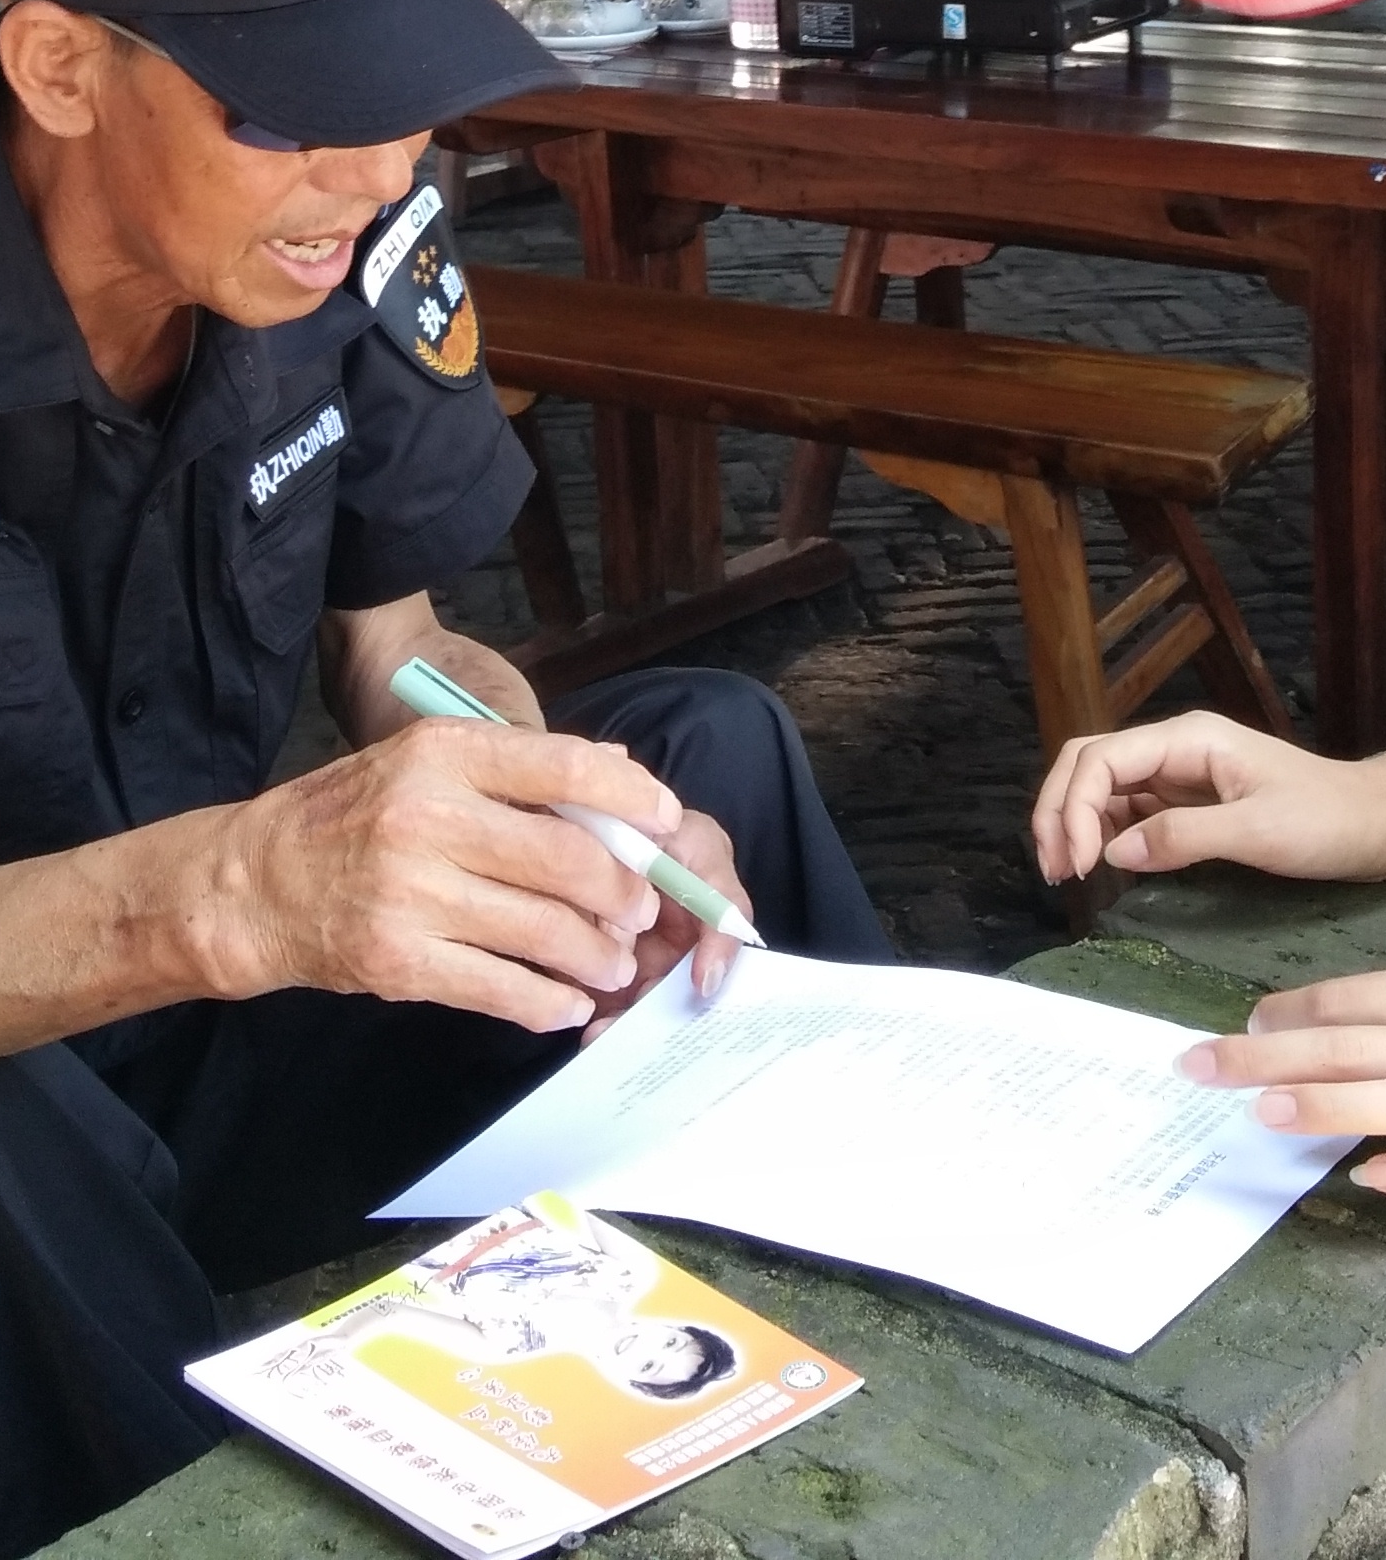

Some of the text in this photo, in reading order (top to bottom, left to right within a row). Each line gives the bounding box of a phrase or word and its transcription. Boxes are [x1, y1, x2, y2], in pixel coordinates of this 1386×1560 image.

[373, 194, 436, 280] ZHI QIN
[417, 261, 464, 342] 执勤
